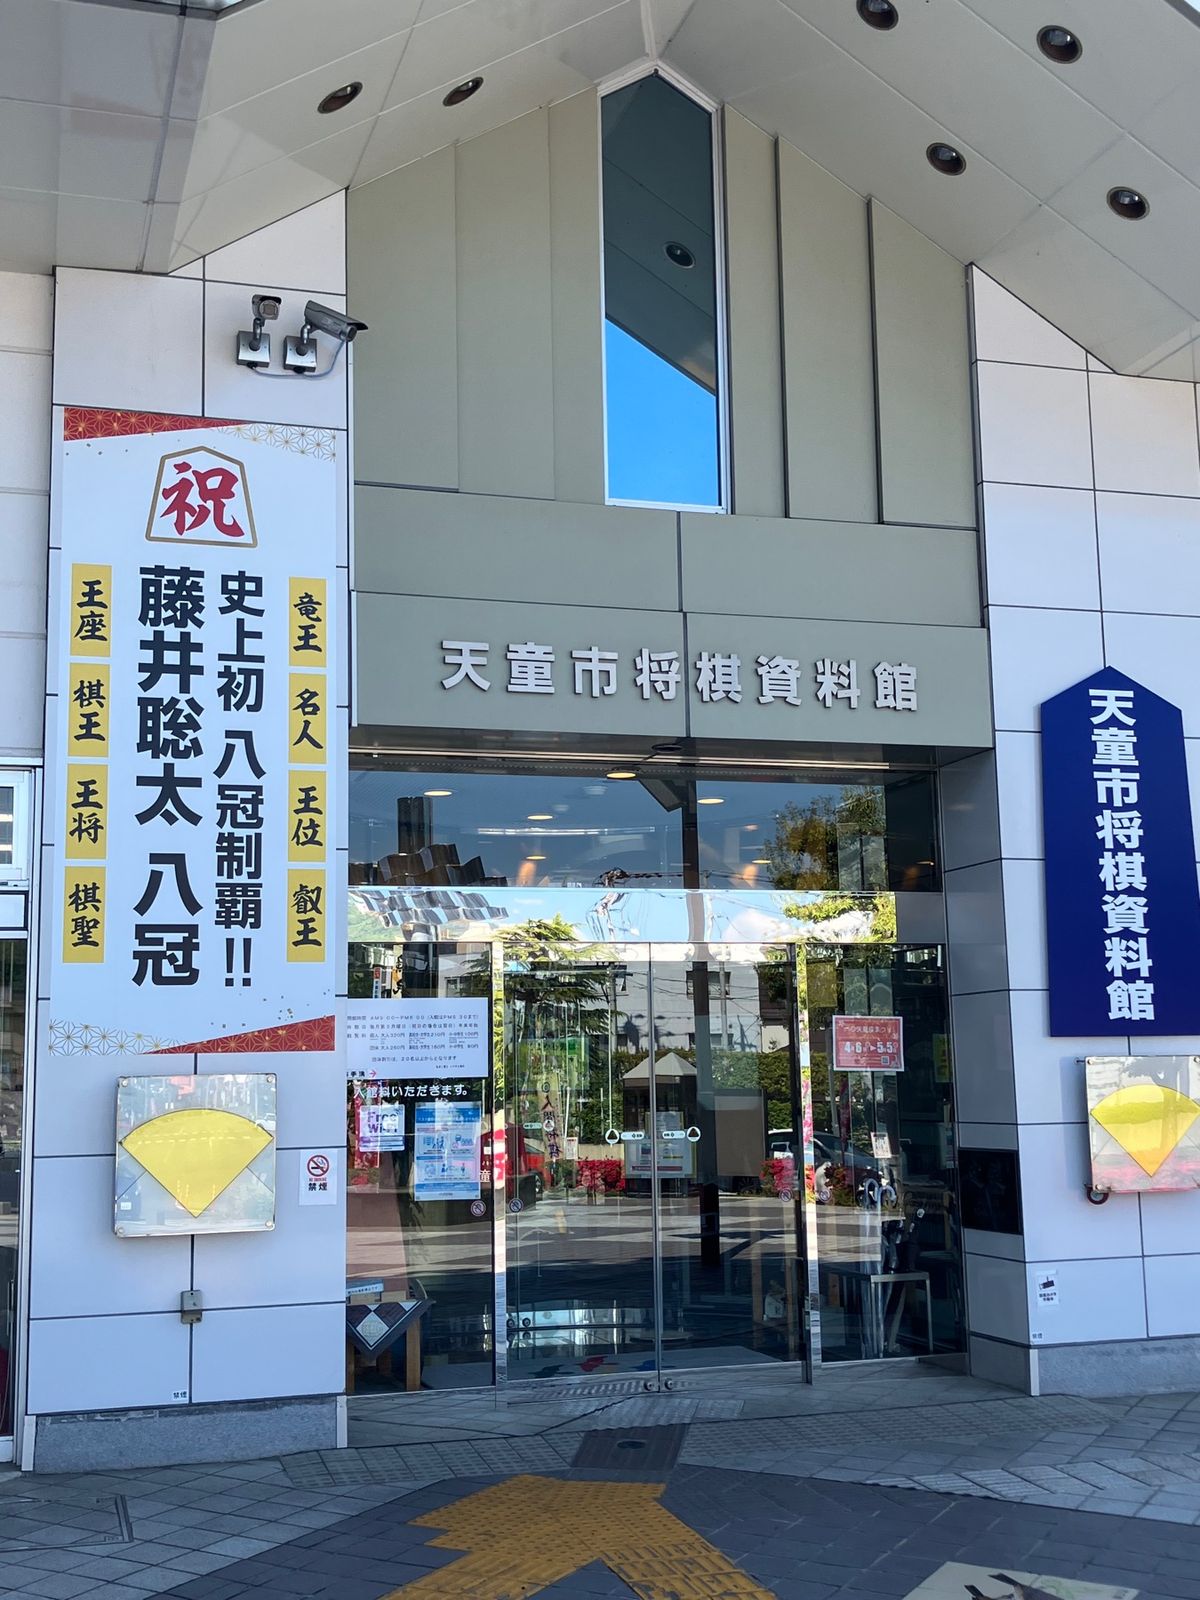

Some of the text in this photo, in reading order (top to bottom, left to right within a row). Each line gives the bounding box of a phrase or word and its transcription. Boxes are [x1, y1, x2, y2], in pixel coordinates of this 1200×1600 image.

[160, 461, 245, 538] 祝
[74, 579, 109, 642] 王座
[216, 571, 266, 713] 史上初
[292, 592, 323, 653] 竜王
[440, 640, 918, 712] 天童市将棋資料館
[72, 679, 107, 742] 棋王
[292, 688, 324, 750] 名人
[131, 565, 205, 987] 藤井聡太 八冠
[68, 779, 105, 844] 王将
[291, 786, 324, 847] 王位
[1088, 688, 1155, 1021] 天童市将棋資料館
[67, 882, 102, 948] 棋聖
[290, 884, 323, 948] 叡王
[308, 1182, 328, 1192] 禁煙
